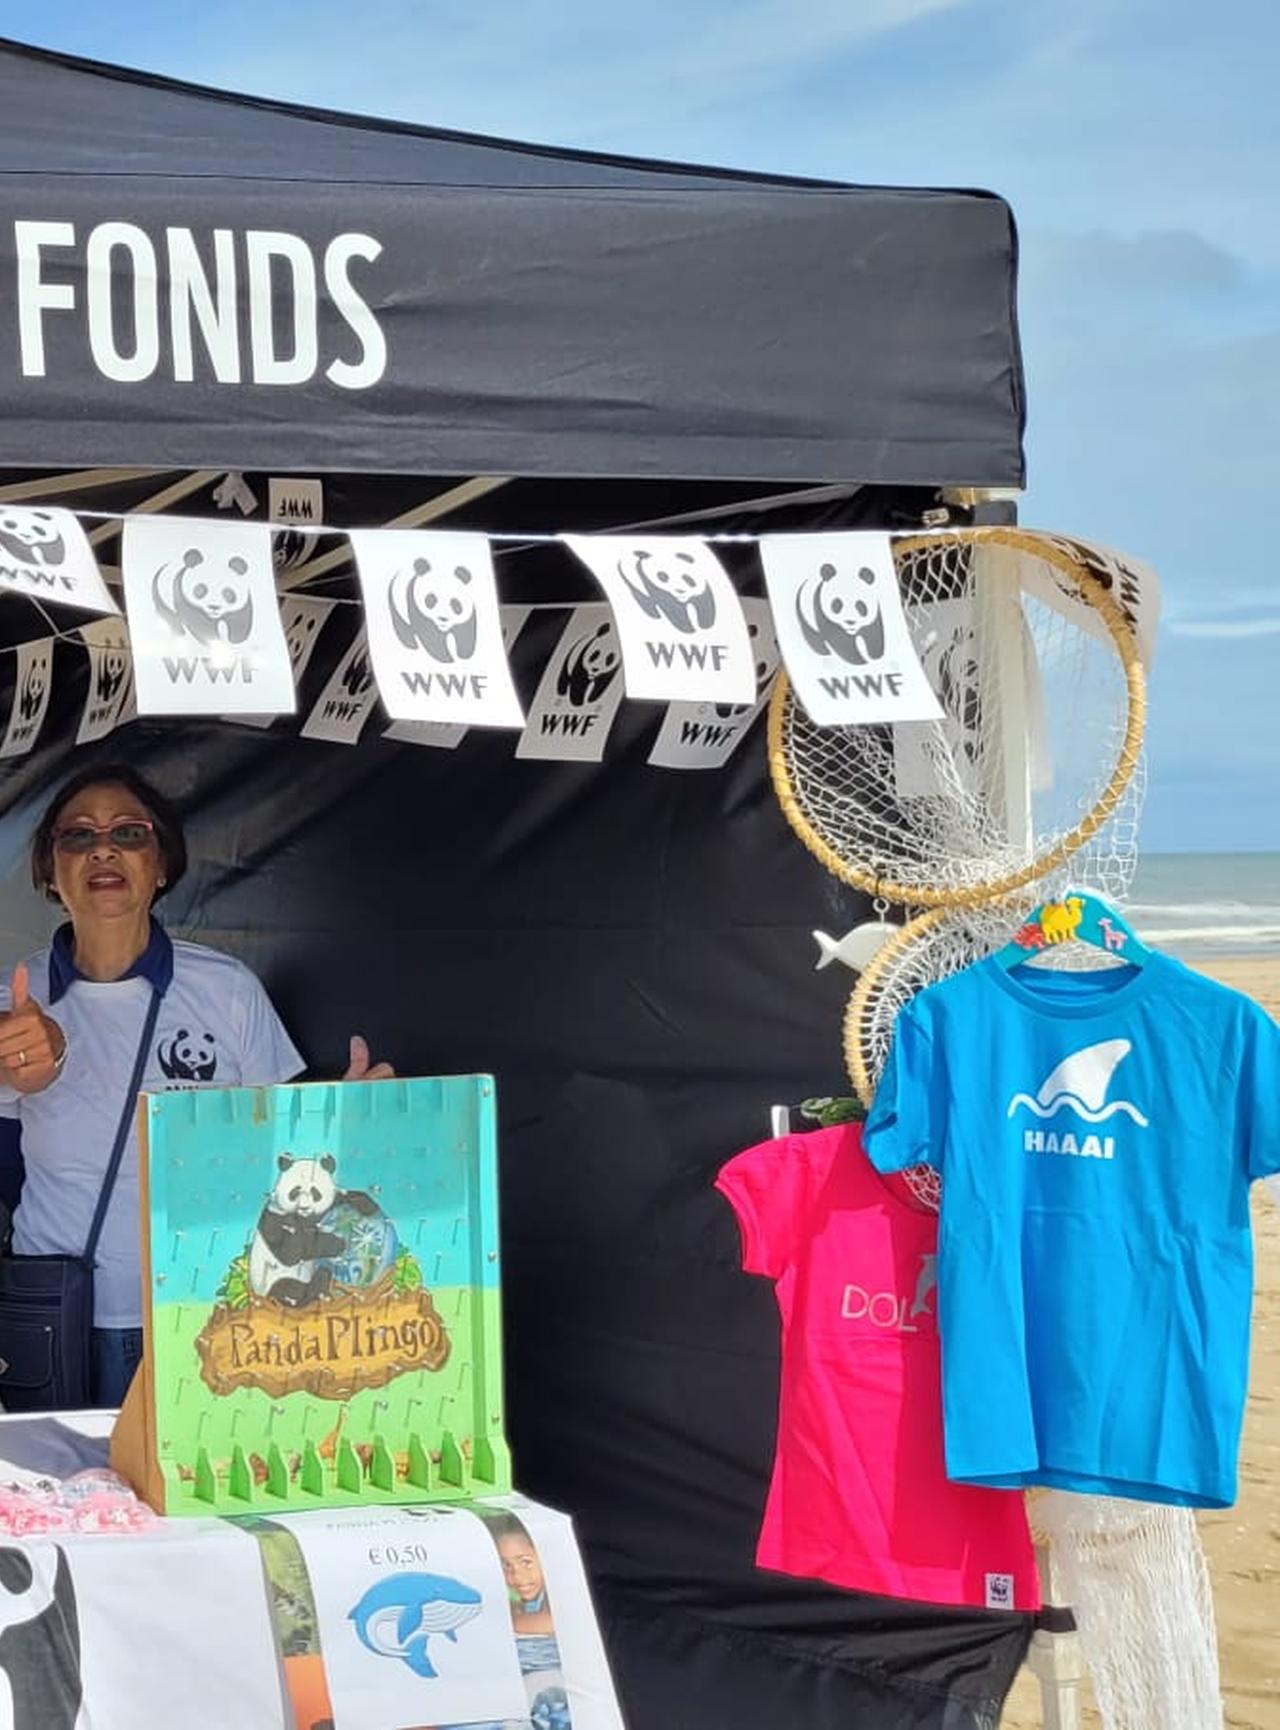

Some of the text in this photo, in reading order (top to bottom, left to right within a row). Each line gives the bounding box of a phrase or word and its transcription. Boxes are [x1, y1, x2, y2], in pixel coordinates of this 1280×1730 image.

[17, 219, 388, 390] FONDS
[164, 656, 258, 684] WWF
[644, 642, 728, 671] WWF
[400, 671, 488, 699] WWF
[817, 672, 905, 701] WWF
[322, 702, 362, 720] WWF
[540, 714, 597, 736] WWF
[679, 720, 740, 745] WWF
[1025, 1130, 1115, 1160] HAAAI
[841, 1284, 917, 1333] DOL
[368, 1543, 428, 1565] € 0,50
